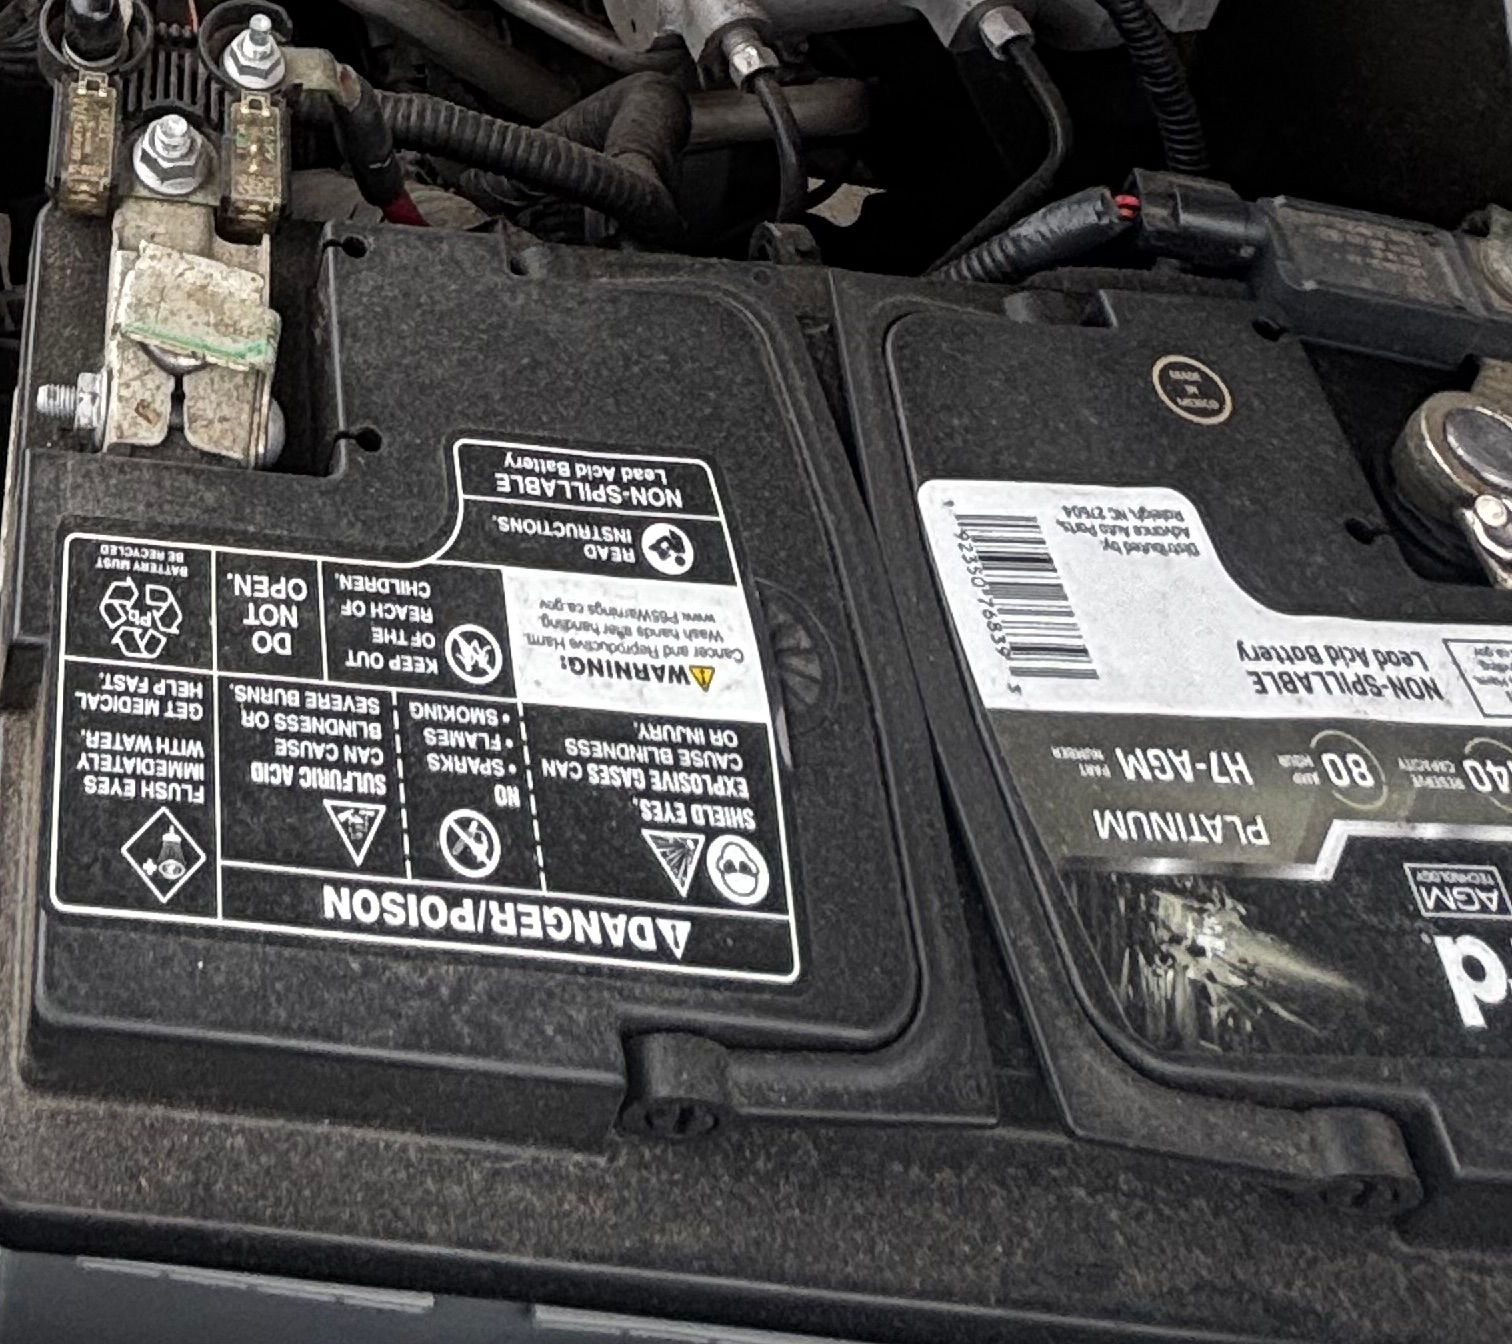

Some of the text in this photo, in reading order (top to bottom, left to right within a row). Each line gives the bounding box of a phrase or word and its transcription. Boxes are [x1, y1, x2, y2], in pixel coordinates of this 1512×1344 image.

[504, 452, 667, 485] Lead Acid Battery
[495, 472, 683, 508] NON-SPILLABLE
[492, 515, 632, 542] INSTRUCTIONS.
[1099, 524, 1130, 538] Auto
[1133, 525, 1190, 539] Advance
[100, 544, 184, 563] BE RECYCLED
[583, 544, 636, 563] READ
[1122, 541, 1200, 558] Distributed
[95, 557, 188, 578] BATTERY MUST
[226, 572, 308, 601] OPEN.
[335, 573, 431, 598] CHILDREN.
[128, 609, 151, 627] Pb
[243, 602, 298, 628] NOT
[340, 599, 433, 624] REACH OF
[251, 630, 292, 655] DO
[371, 626, 436, 649] OF THE
[538, 614, 724, 643] Wash hands after handling.
[345, 649, 439, 675] KEEP OUT
[523, 632, 745, 664] Cancer and Reproductive Harm.
[1236, 640, 1429, 672] Lead Acid Battery
[560, 655, 690, 685] WARNING:
[98, 672, 203, 700] HELP FAST.
[229, 683, 380, 715] SEVERE BURNS.
[1246, 670, 1444, 701] NON-SPILLABLE
[74, 691, 203, 721] GET MEDICAL
[409, 701, 498, 726] SMOKING
[240, 710, 382, 739] BLINDNESS OR
[633, 721, 738, 747] OR INJURY.
[81, 728, 205, 758] WITH WATER.
[274, 738, 384, 766] CAN CAUSE
[423, 727, 501, 751] FLAMES
[76, 752, 204, 781] IMMEDIATELY
[426, 752, 505, 776] SPARKS
[564, 738, 743, 771] CAUSE BLINDNESS
[1114, 747, 1254, 786] H7-AGM
[250, 761, 386, 795] SULFURIC ACID
[541, 758, 749, 800] EXPLOSIVE GASES CAN
[1078, 763, 1112, 778] PART
[1321, 753, 1375, 787] 80
[83, 775, 205, 804] FLUSH EYES
[494, 784, 521, 808] NO
[632, 796, 756, 831] SHIELD EYES.
[1092, 809, 1270, 846] PLATINUM
[1416, 870, 1495, 885] TECHNOLOGY
[1419, 886, 1498, 912] AGM
[322, 884, 657, 951] DANGER/POISON
